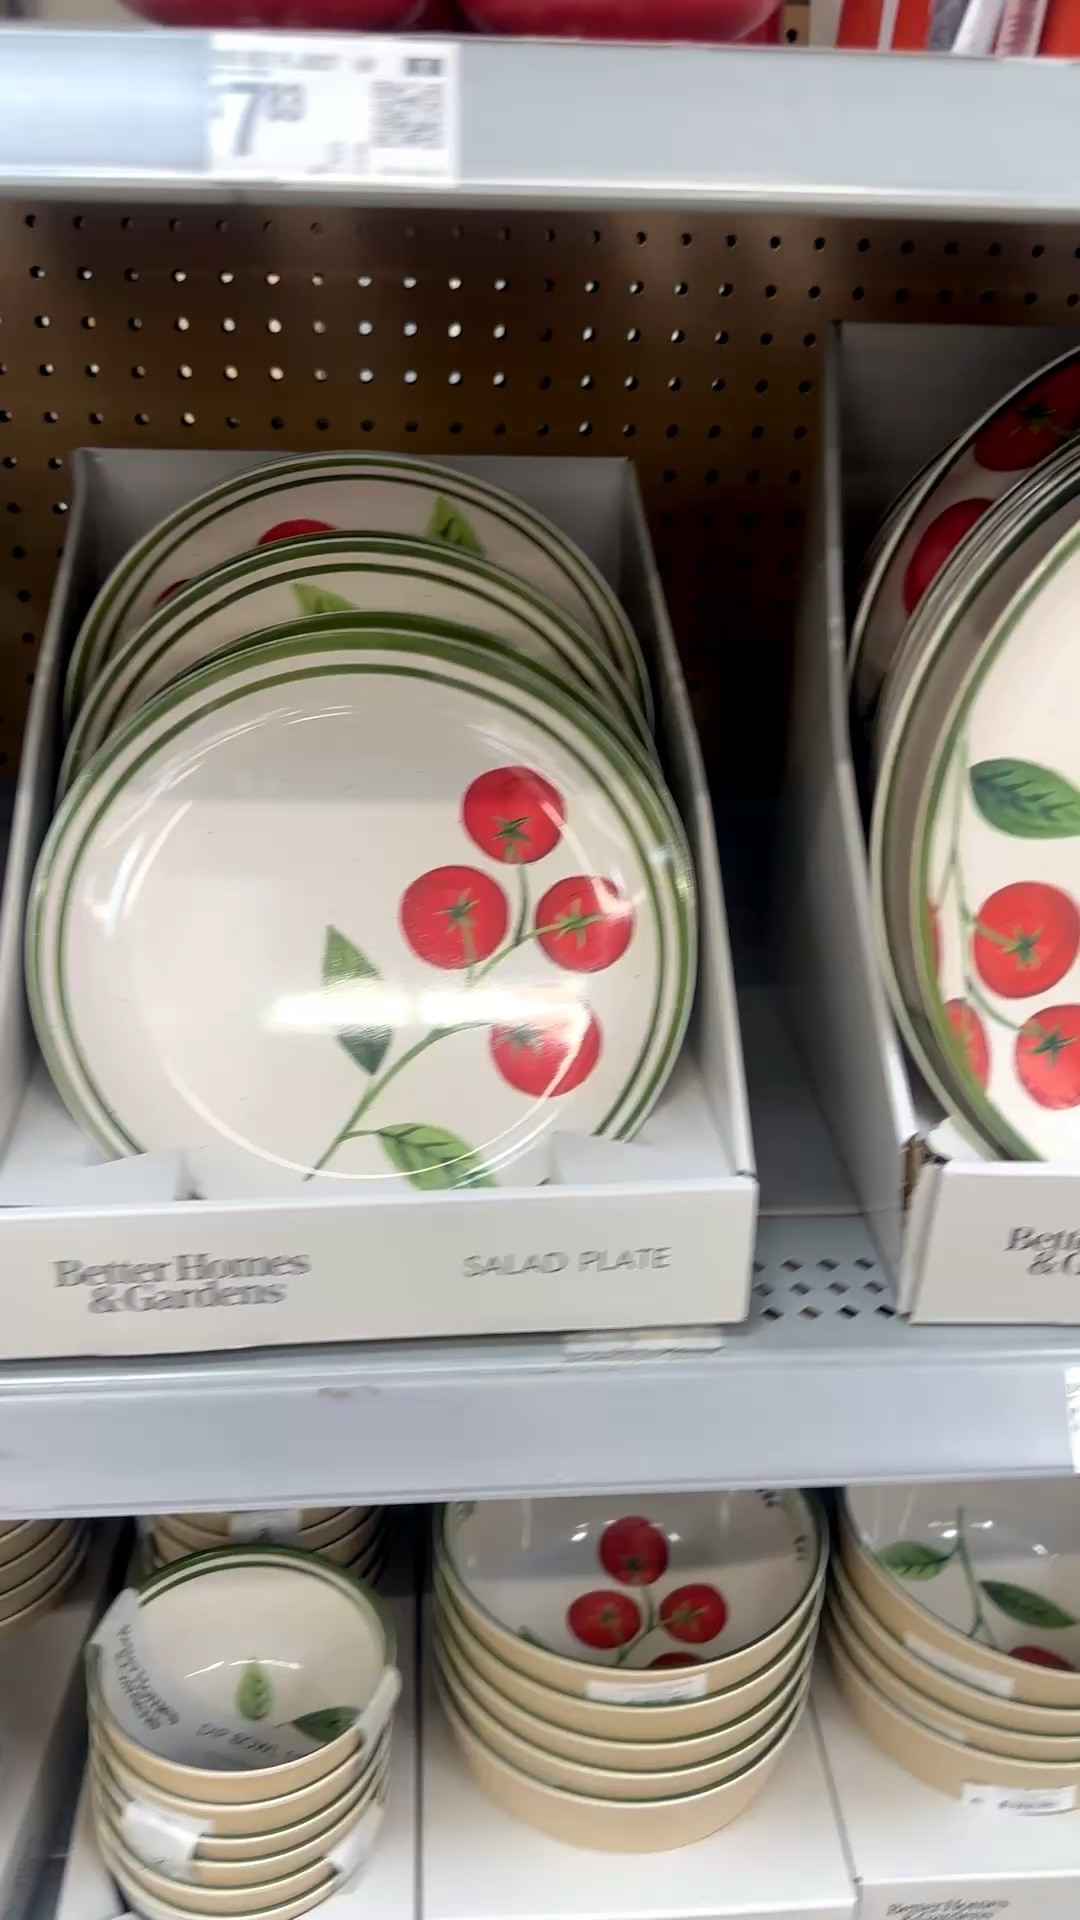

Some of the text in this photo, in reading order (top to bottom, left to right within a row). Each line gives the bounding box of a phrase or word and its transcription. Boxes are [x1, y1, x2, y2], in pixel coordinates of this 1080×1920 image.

[51, 1253, 311, 1287] Better Homes
[463, 1247, 672, 1277] SALAD PLATE
